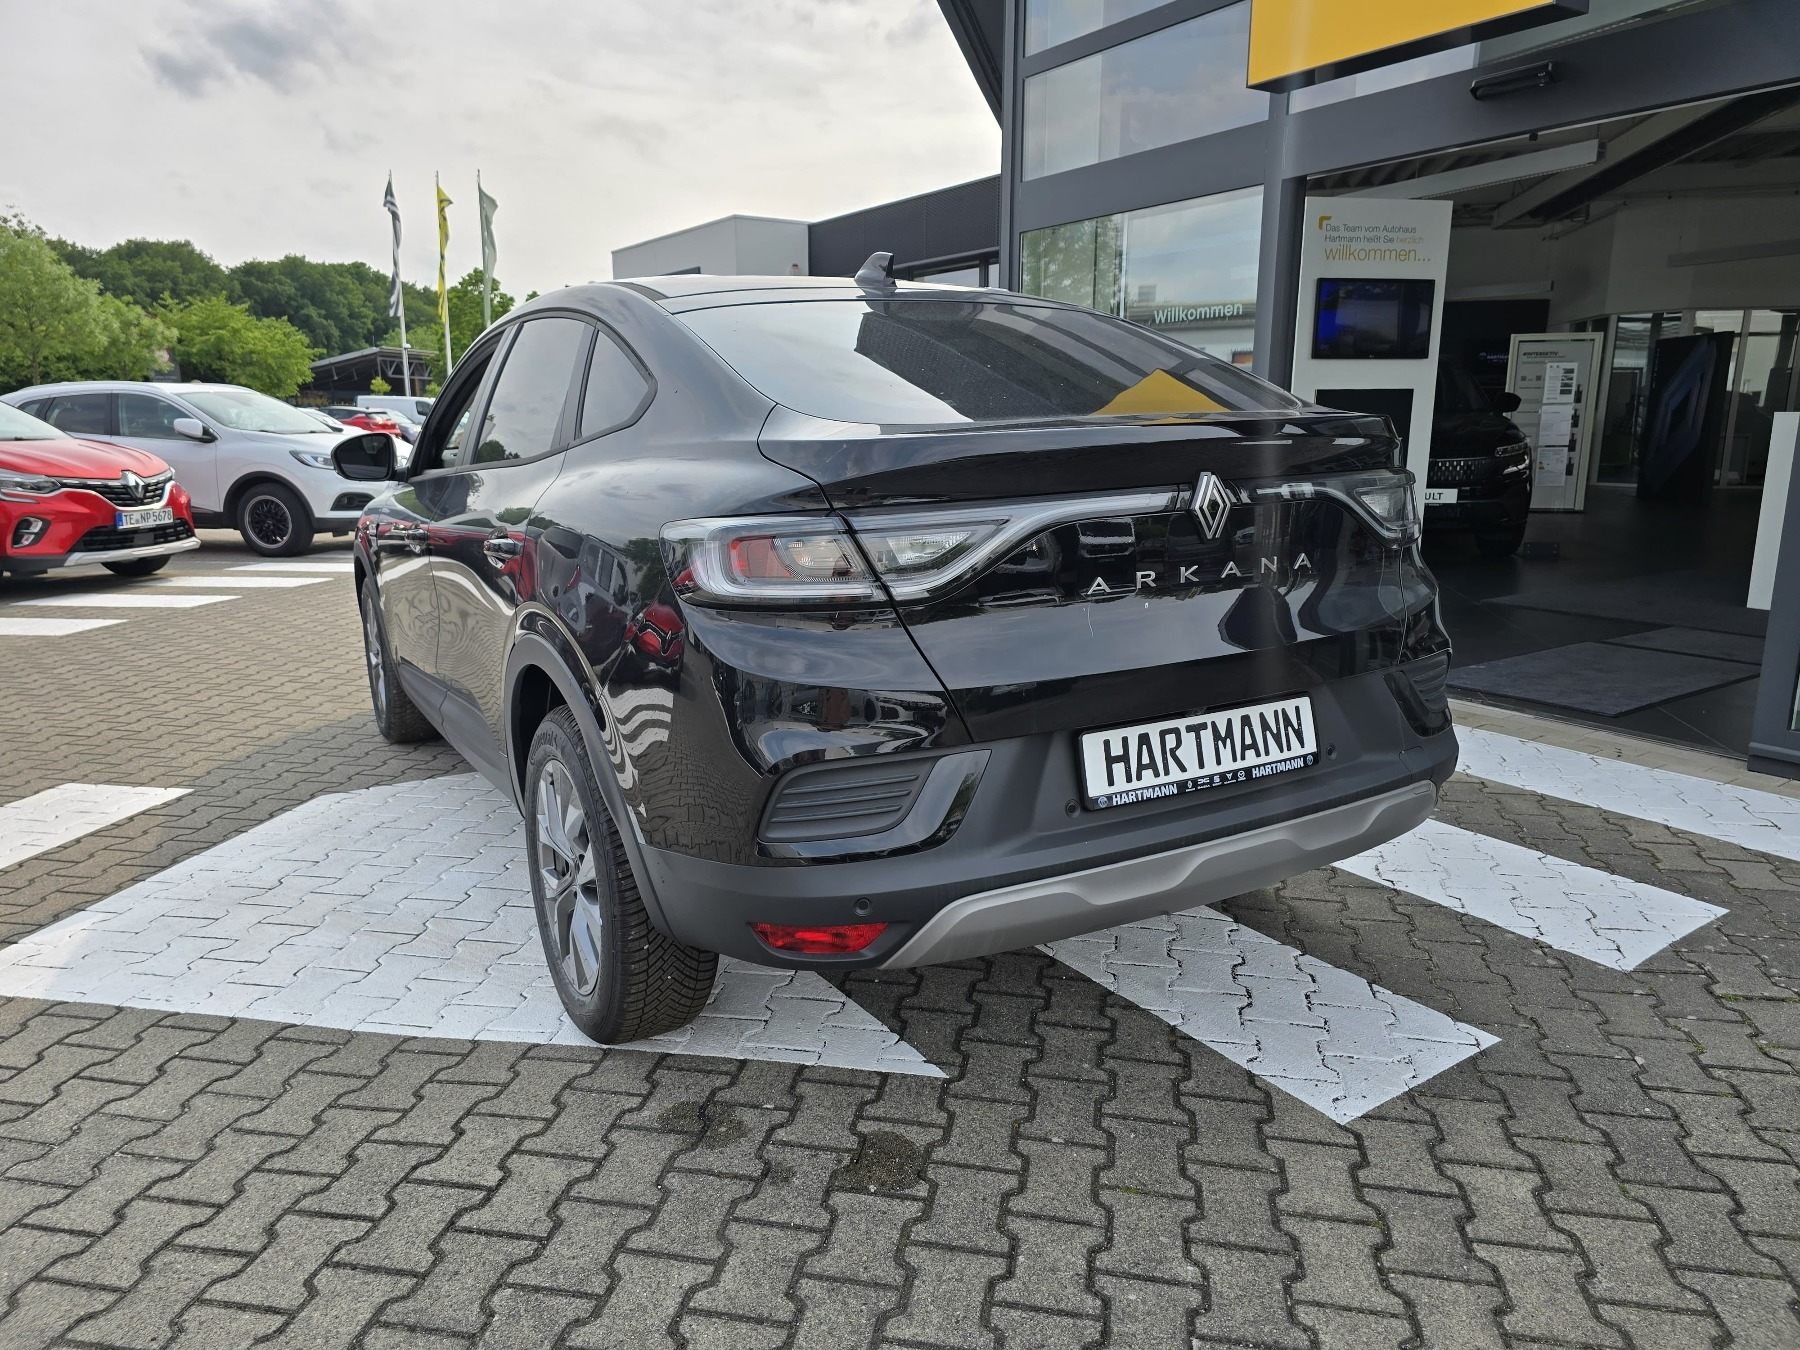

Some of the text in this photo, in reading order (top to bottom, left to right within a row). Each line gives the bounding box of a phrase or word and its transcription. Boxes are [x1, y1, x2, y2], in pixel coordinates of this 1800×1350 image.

[1325, 223, 1341, 233] Das
[1342, 223, 1363, 233] Team
[1382, 224, 1417, 233] Autohaus
[1324, 233, 1424, 244] Hartmann heißt Sie herzlich
[1324, 244, 1431, 262] willkommen...
[1154, 303, 1243, 324] Willkommen
[124, 509, 172, 525] TE NP 5678
[1086, 552, 1312, 596] ARKANA
[1102, 705, 1305, 787] HARTMANN
[1112, 783, 1178, 806] HARTMANN
[1252, 757, 1305, 779] HARTMANN
